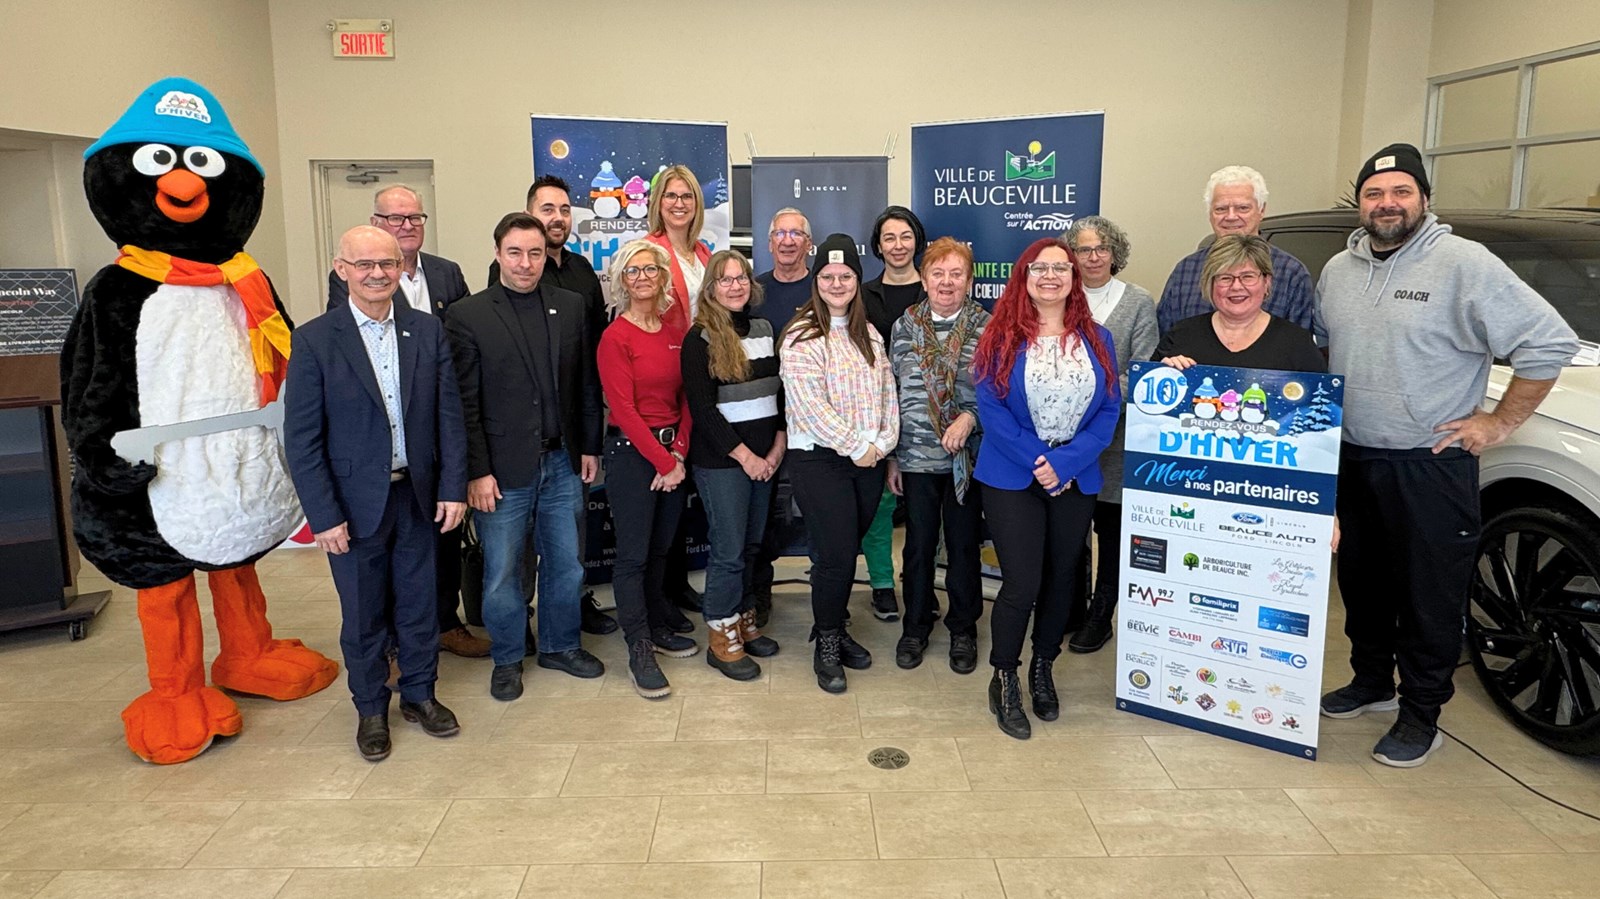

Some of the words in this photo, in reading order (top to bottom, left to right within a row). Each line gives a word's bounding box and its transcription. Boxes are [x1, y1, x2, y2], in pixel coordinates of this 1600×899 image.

[340, 33, 387, 55] SORTIE
[157, 107, 209, 122] D'HIVER
[934, 167, 975, 183] VILLE
[979, 170, 996, 182] DE
[934, 184, 1077, 206] BEAUCEVILLE
[1004, 211, 1034, 220] Centrée
[33, 287, 57, 297] Way
[1394, 289, 1430, 302] COACH
[1190, 418, 1267, 433] RENDEZ-VOUS
[1159, 430, 1298, 467] D'HIVER
[1134, 459, 1208, 487] Merci
[1184, 479, 1191, 489] à
[1192, 482, 1211, 492] nos
[1213, 479, 1320, 505] partenaires
[1131, 504, 1154, 515] VILLE
[1131, 513, 1206, 533] BEAUCEVILLE
[1218, 524, 1273, 538] BEAUCE
[1276, 533, 1317, 544] AUTO
[1231, 533, 1255, 541] FORD
[1265, 539, 1303, 548] LINCOLN
[1202, 563, 1211, 571] DE
[1212, 564, 1236, 575] BEAUCE
[1203, 556, 1252, 571] ARBORICULTURE
[1157, 588, 1174, 598] 99.7
[1201, 597, 1237, 610] familiprix
[1168, 629, 1202, 642] CAMBI
[1222, 640, 1248, 656] SVC
